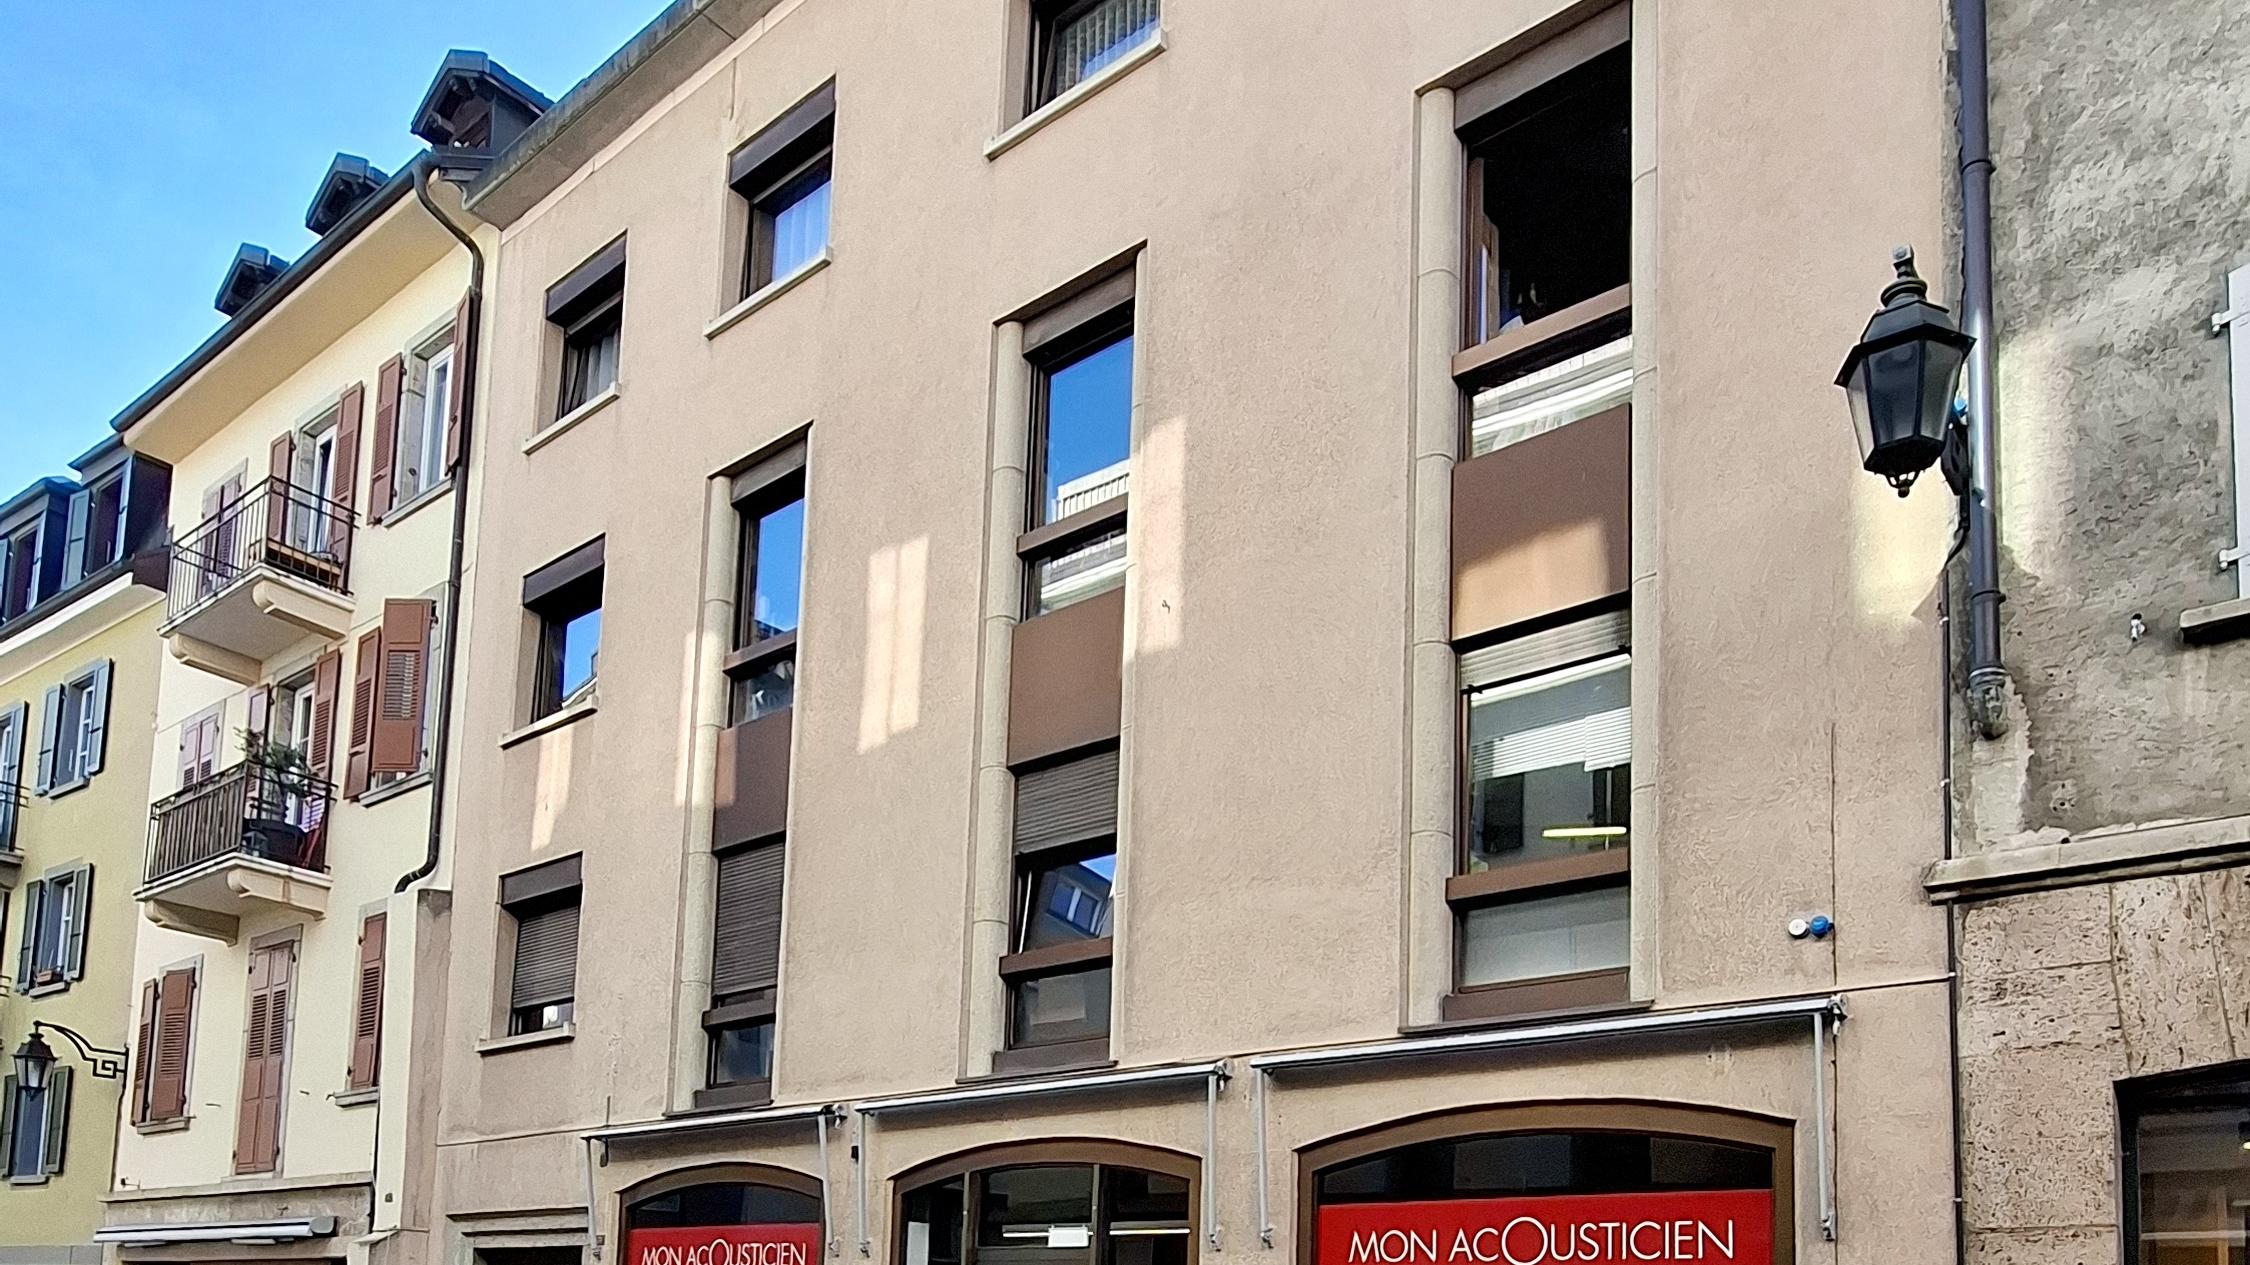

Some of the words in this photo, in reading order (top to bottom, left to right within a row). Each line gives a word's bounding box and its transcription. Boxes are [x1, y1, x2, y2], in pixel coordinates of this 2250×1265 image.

[641, 1245, 683, 1265] MON
[686, 1238, 807, 1265] ACOUSTICIEN
[1348, 1229, 1437, 1263] MON
[1448, 1216, 1735, 1265] ACOUSTICIEN
